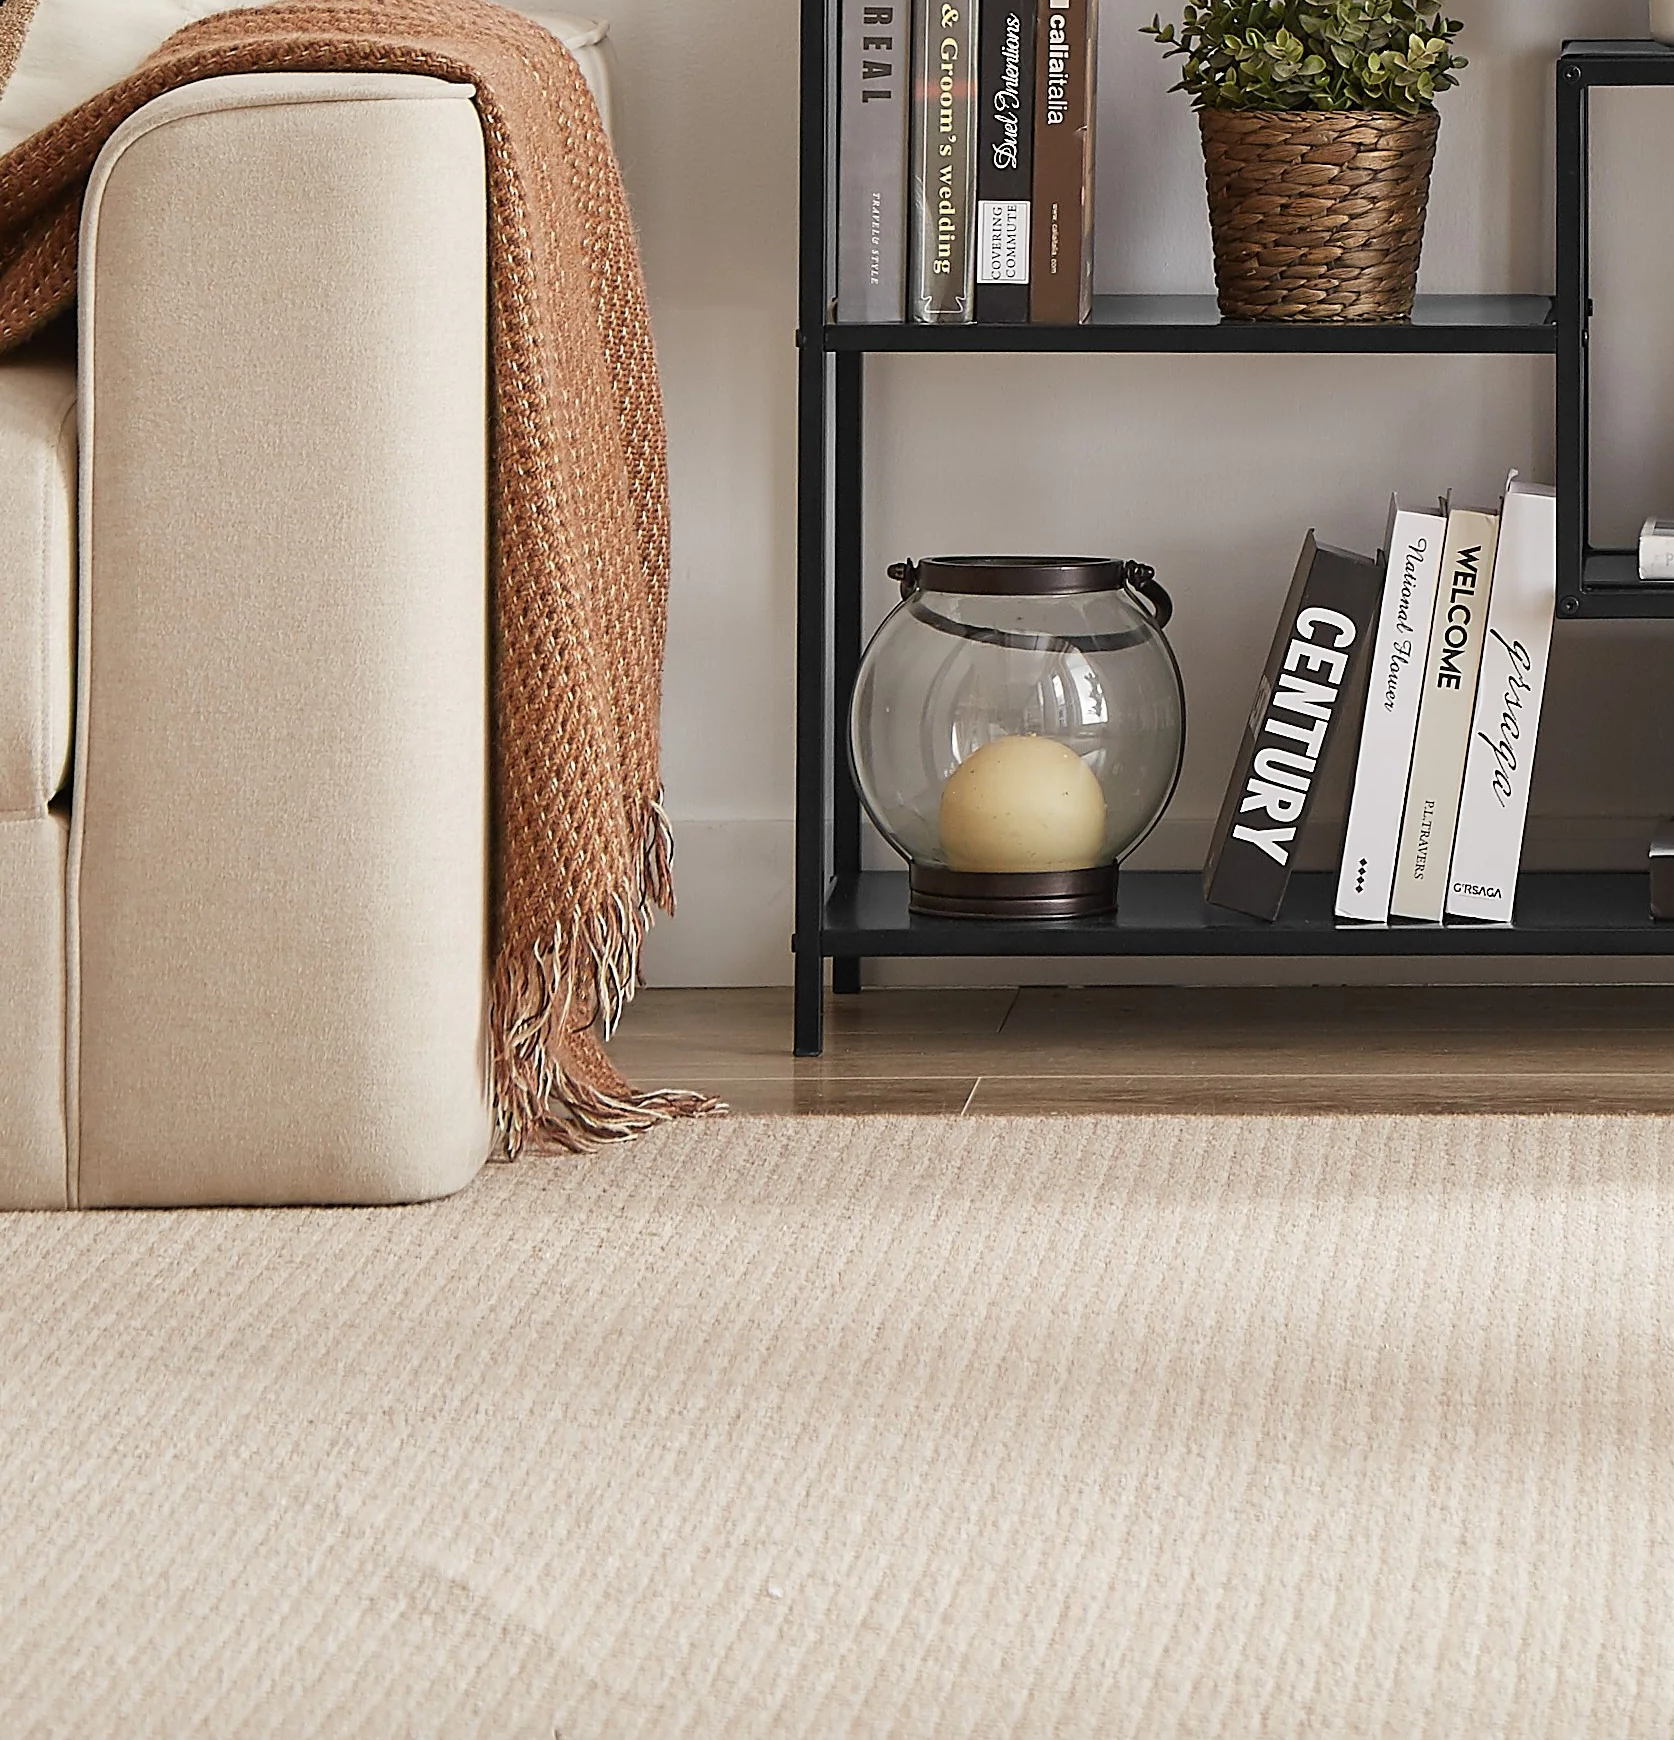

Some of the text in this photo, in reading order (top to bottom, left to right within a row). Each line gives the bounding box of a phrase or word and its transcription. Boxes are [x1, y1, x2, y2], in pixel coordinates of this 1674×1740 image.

[940, 3, 960, 28] &
[1047, 14, 1070, 125] caliaitalia
[938, 37, 960, 157] Groom's
[932, 165, 958, 274] wedding
[990, 207, 1003, 280] COVERING
[1005, 204, 1018, 278] COMMUTE
[1384, 538, 1427, 712] National Flower
[1437, 545, 1482, 690] WELCOME
[1232, 607, 1357, 866] CENTURY
